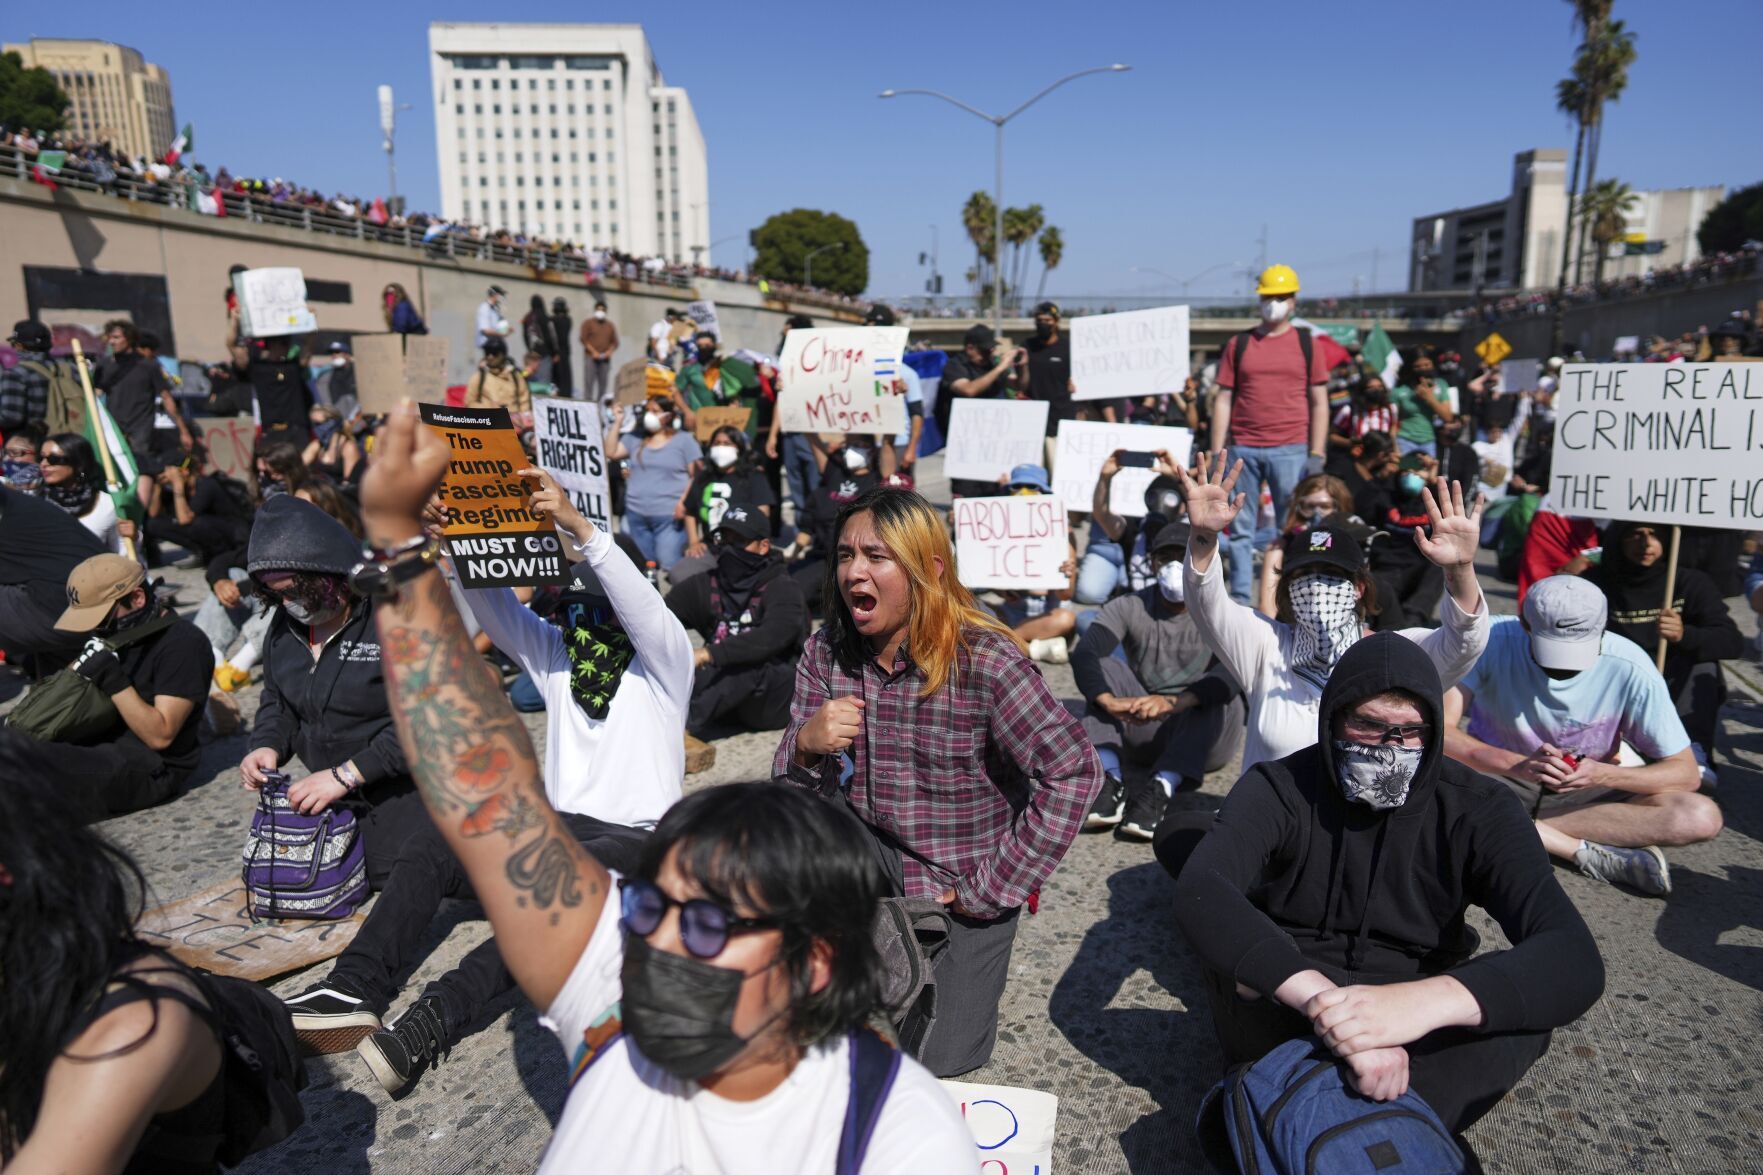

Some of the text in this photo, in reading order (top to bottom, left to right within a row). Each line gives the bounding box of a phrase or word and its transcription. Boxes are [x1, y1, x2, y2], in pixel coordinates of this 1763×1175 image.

[827, 383, 852, 407] tu
[1566, 368, 1763, 402] THE REAL
[546, 406, 588, 441] FULL
[806, 394, 883, 431] Migra!
[446, 432, 484, 450] The
[1561, 408, 1763, 452] CRIMINAL I
[449, 458, 513, 479] rump
[540, 438, 603, 478] RIGHTS
[437, 480, 533, 501] Fascist
[576, 490, 608, 521] ALL
[1556, 474, 1611, 511] THE
[1629, 477, 1718, 515] WHITE
[447, 504, 547, 529] Regime
[957, 501, 1067, 542] ABOLISH
[451, 536, 560, 557] MUST GO
[987, 545, 1042, 578] ICE
[467, 556, 561, 580] NOW!!!
